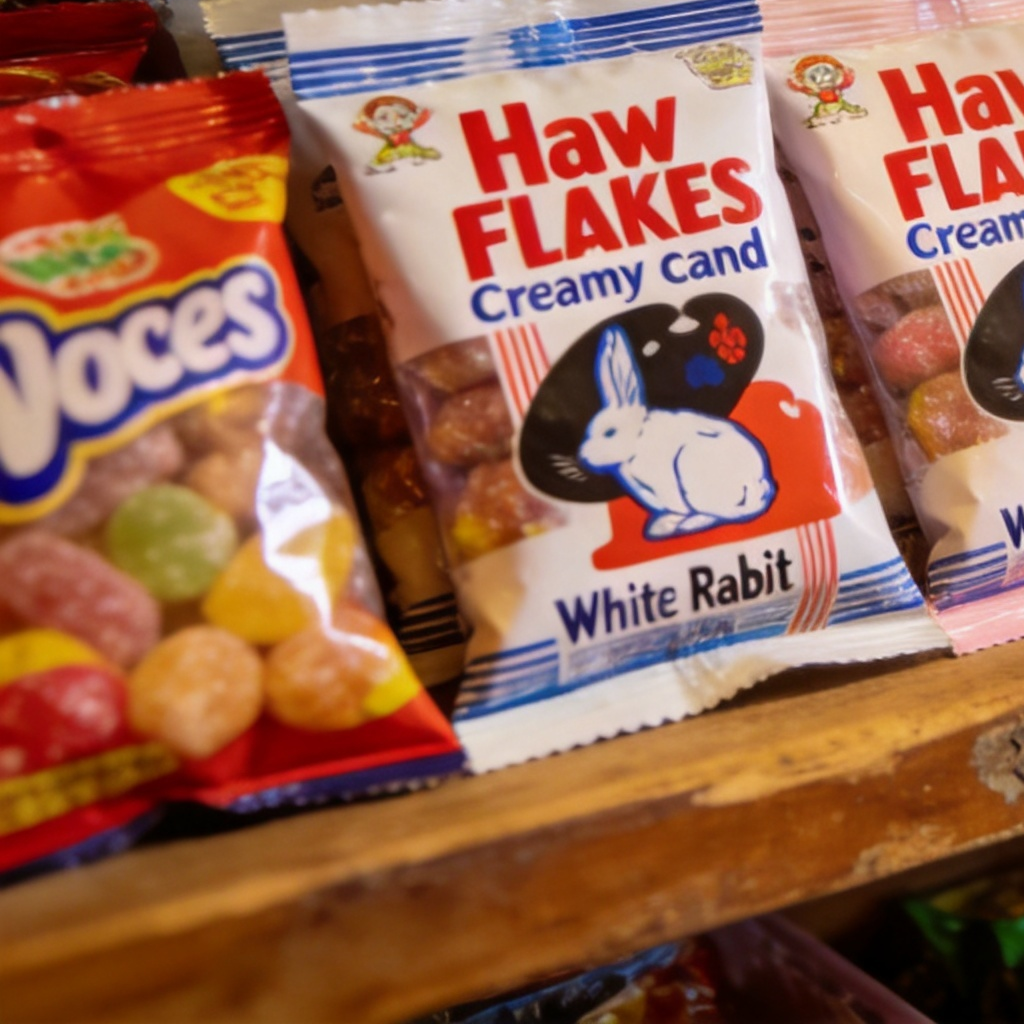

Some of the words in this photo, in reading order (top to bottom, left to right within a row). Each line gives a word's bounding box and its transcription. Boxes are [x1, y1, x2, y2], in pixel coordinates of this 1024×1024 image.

[459, 96, 677, 193] Haw
[452, 157, 763, 282] FLAKES
[470, 260, 644, 323] Creamy
[555, 582, 678, 644] White
[689, 548, 794, 612] Rabit
